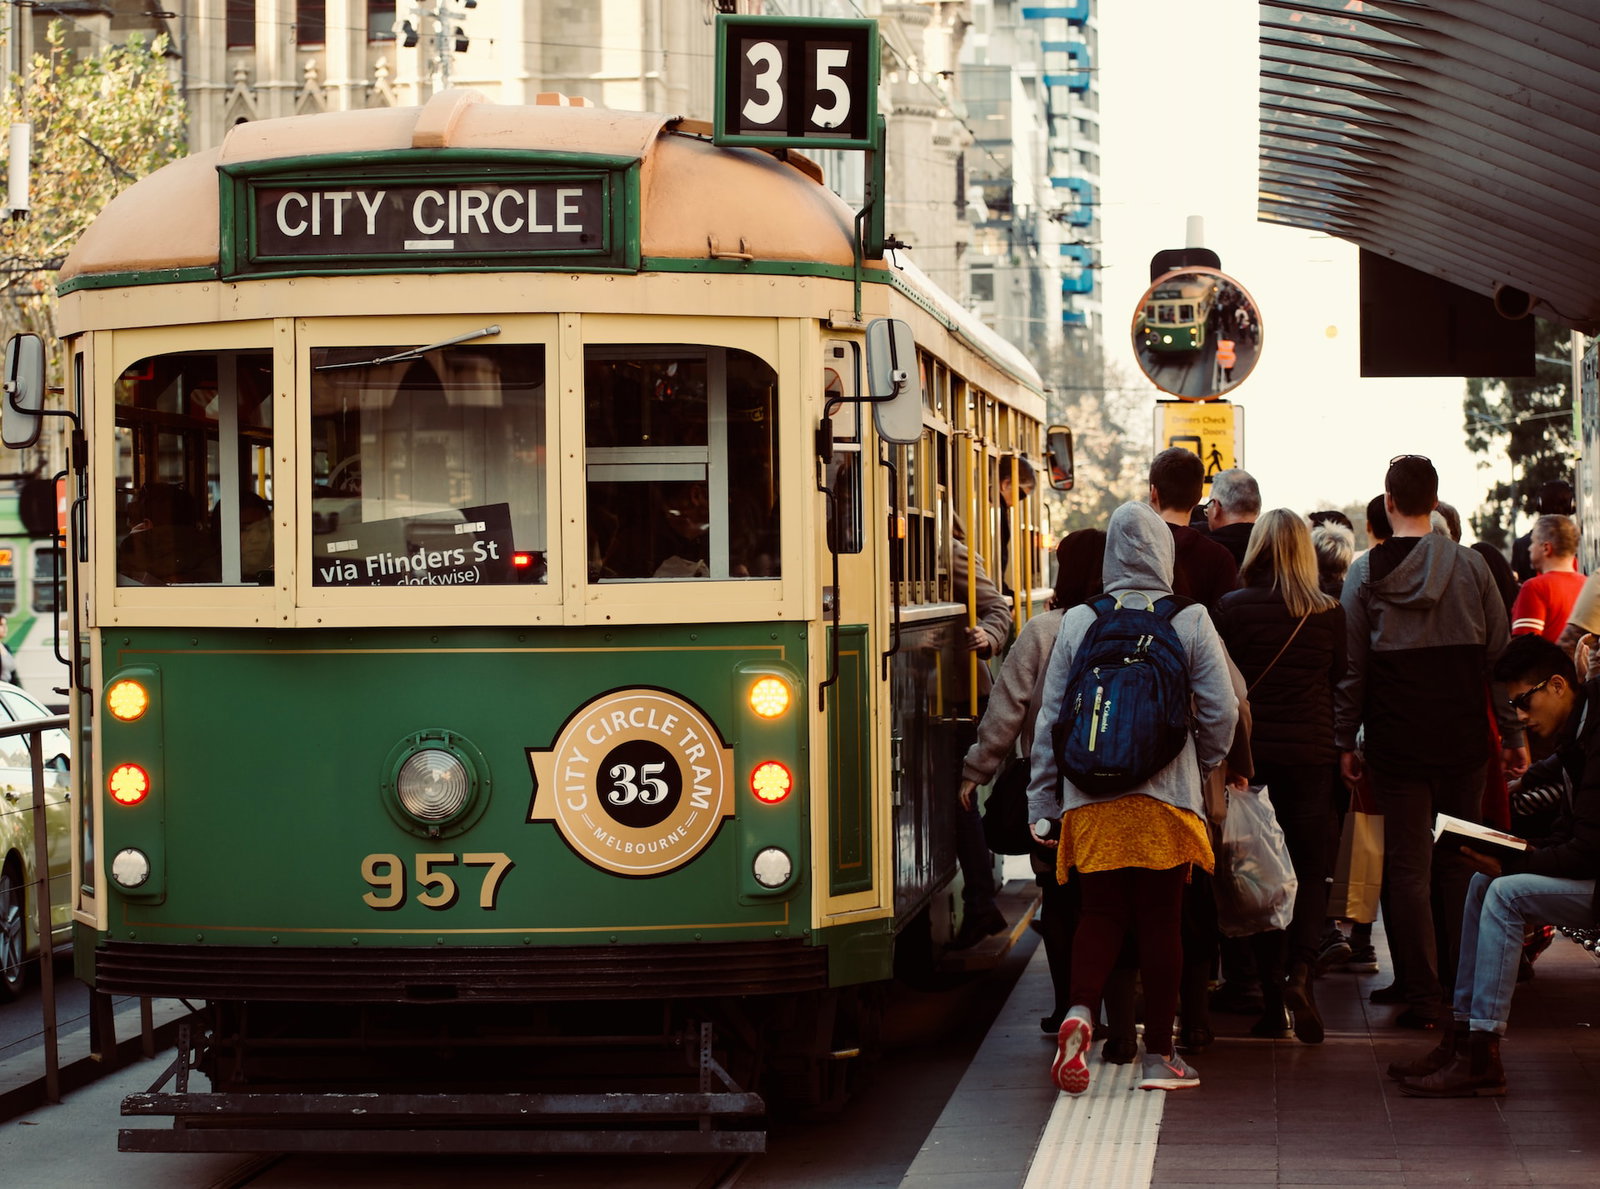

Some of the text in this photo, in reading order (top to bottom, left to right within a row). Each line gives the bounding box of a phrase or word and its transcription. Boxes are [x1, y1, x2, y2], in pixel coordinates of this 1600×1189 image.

[276, 188, 583, 237] CITY CIRCLE
[1202, 416, 1226, 424] Check
[1202, 428, 1226, 436] Doors
[320, 540, 500, 584] via Flinders St
[565, 706, 713, 812] CITY CIRCLE TRAM
[607, 761, 669, 806] 35
[593, 825, 688, 855] MELBOURNE
[361, 852, 516, 911] 957
